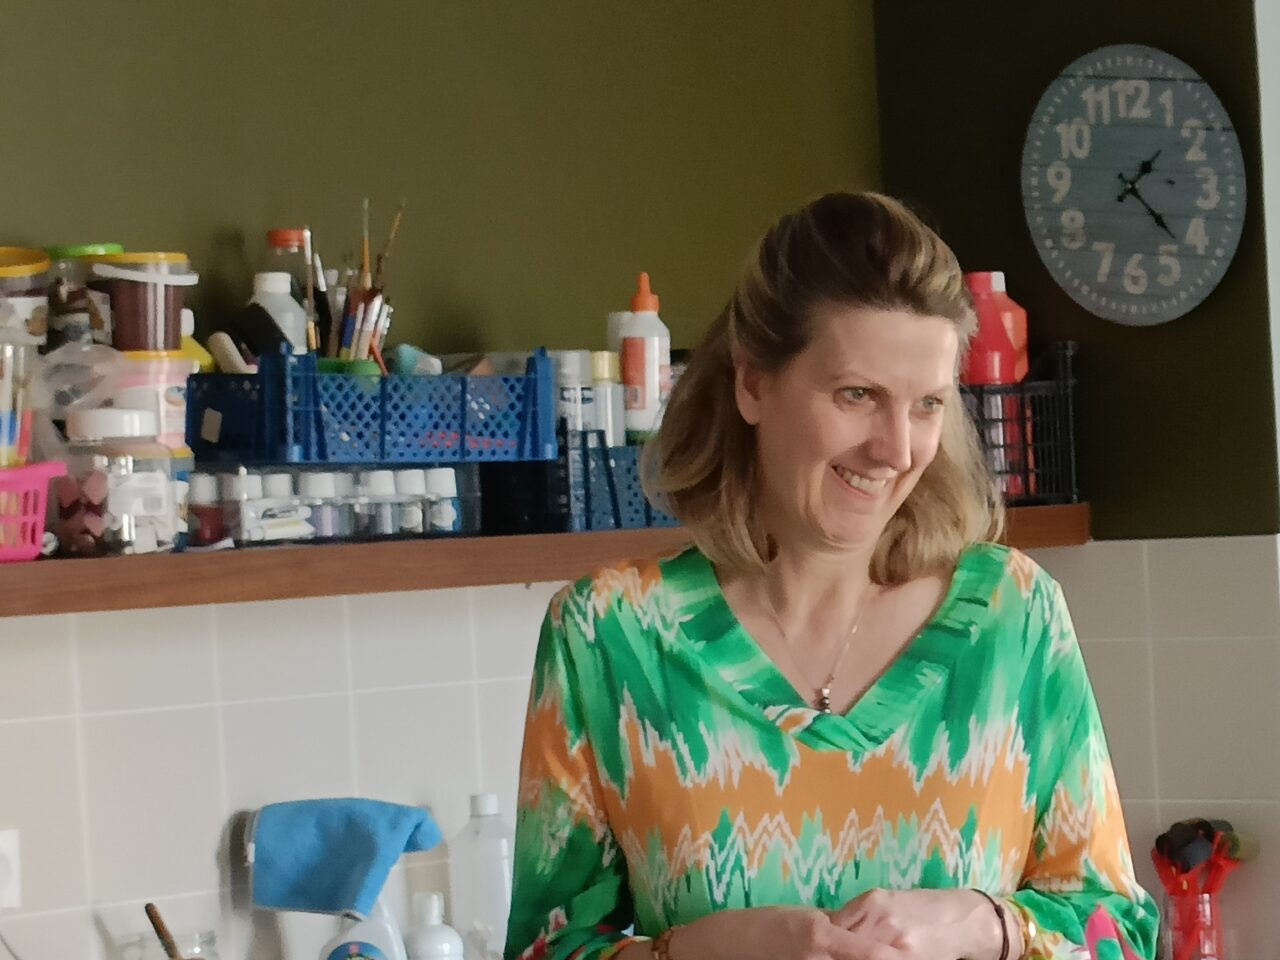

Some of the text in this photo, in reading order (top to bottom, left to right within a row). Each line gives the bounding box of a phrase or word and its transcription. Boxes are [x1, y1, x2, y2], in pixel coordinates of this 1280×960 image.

[1081, 79, 1175, 128] 11 12 1
[1055, 116, 1092, 160] 10
[1180, 118, 1208, 162] 2
[1046, 160, 1072, 204] 9
[1195, 166, 1221, 211] 3
[1060, 208, 1086, 250] 8
[1184, 215, 1209, 255] 4
[1092, 240, 1182, 296] 7 6 5
